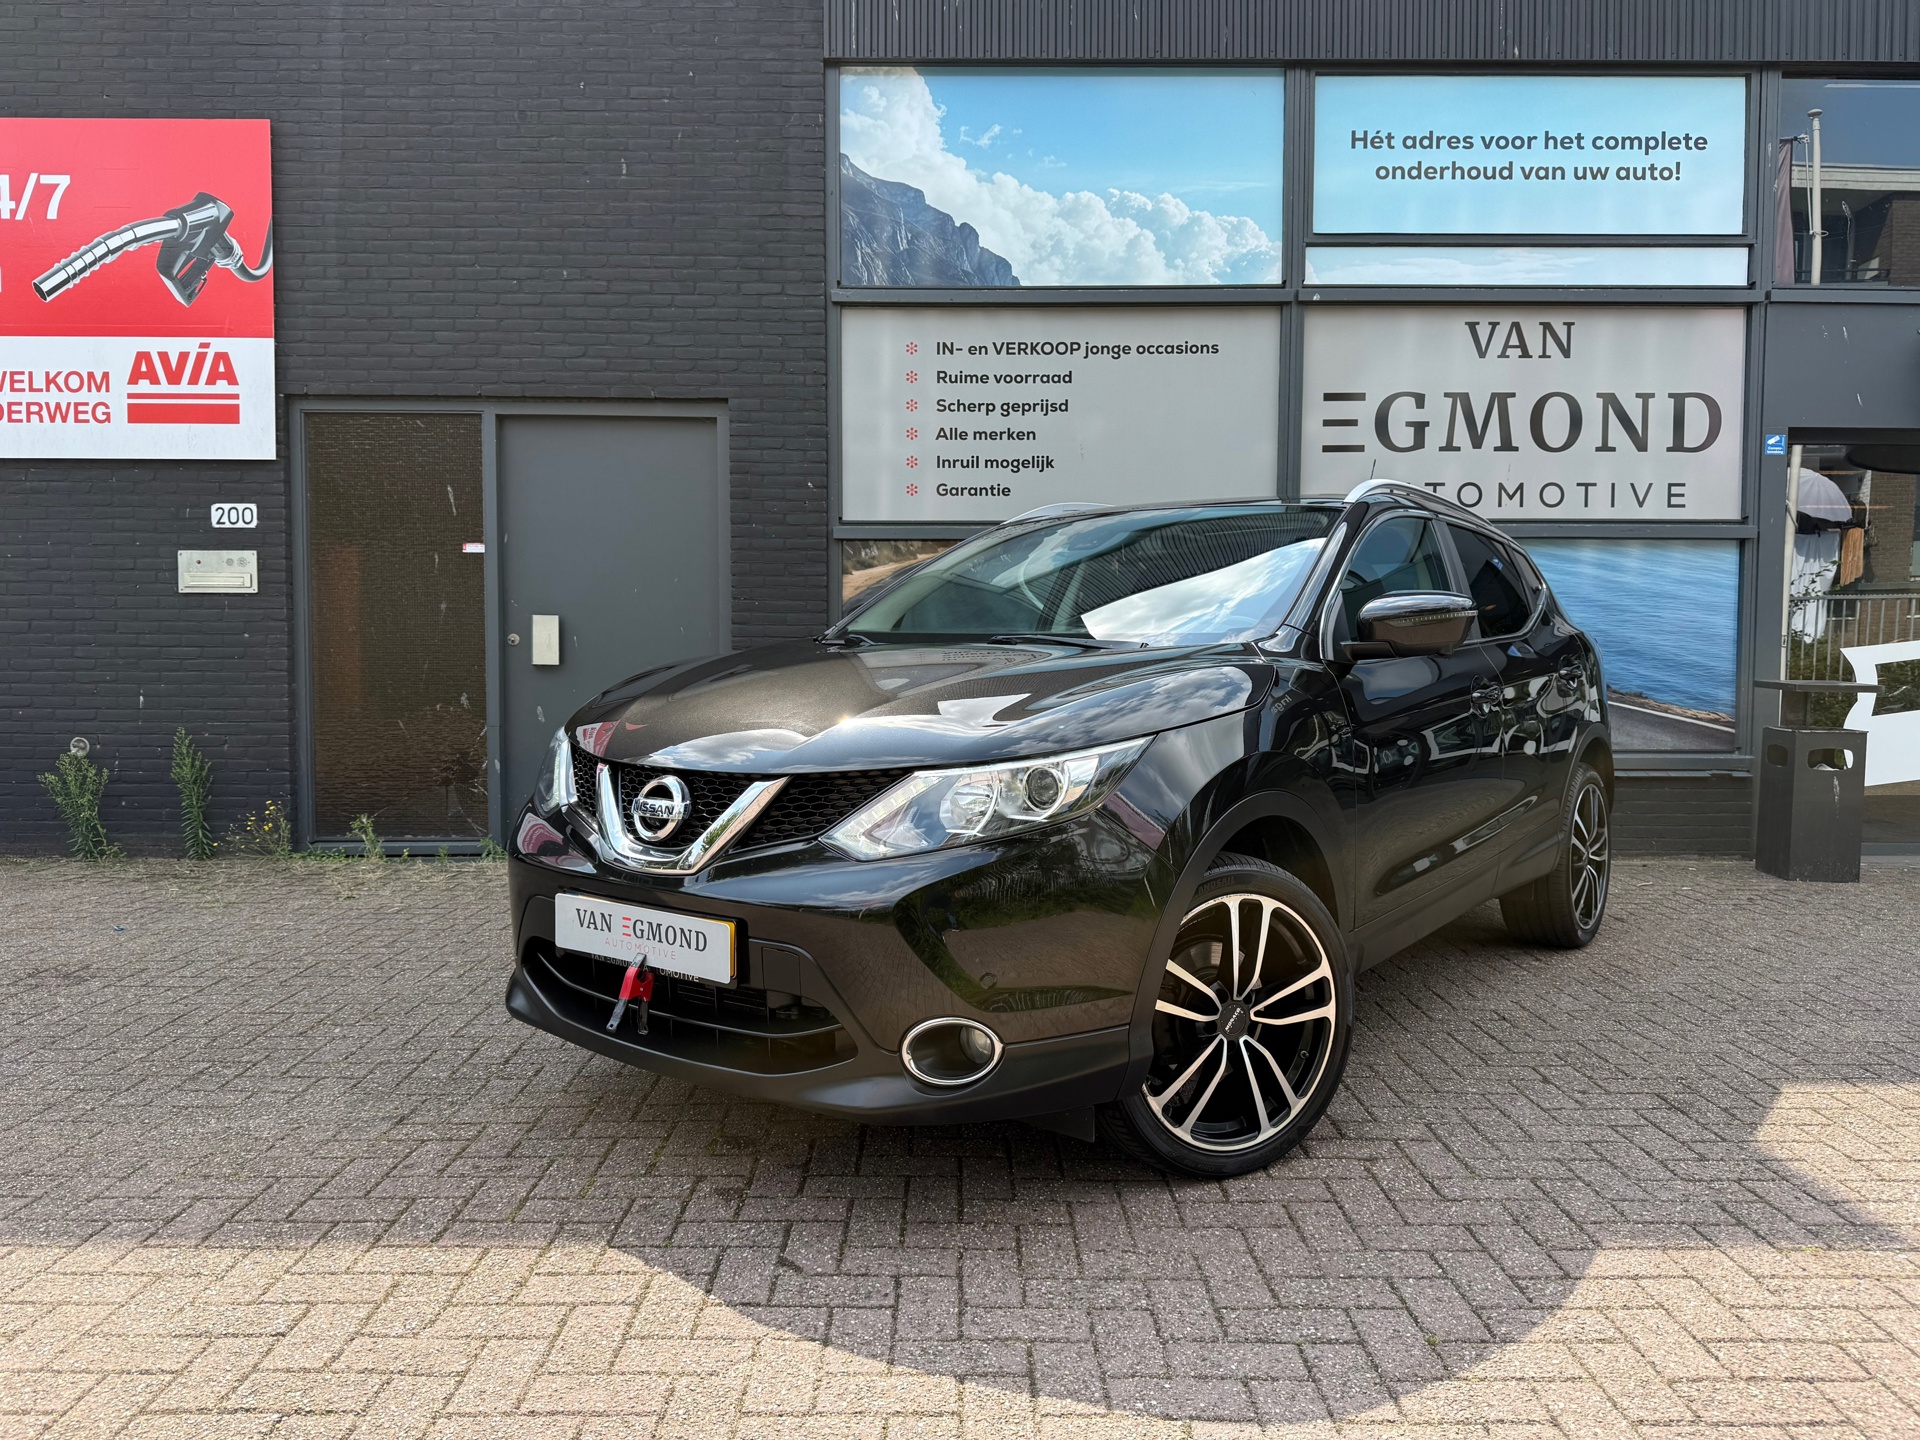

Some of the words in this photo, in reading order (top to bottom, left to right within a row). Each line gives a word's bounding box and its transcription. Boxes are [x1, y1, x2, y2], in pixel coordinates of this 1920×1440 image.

[1350, 129, 1395, 150] Hét
[1402, 130, 1474, 150] adres
[1480, 135, 1538, 150] voor
[1544, 130, 1584, 150] het
[1591, 130, 1708, 156] complete
[1375, 160, 1514, 181] onderhoud
[1519, 166, 1566, 181] van
[1573, 166, 1610, 181] uw
[1615, 161, 1681, 181] auto!
[936, 341, 963, 356] IN-
[967, 345, 988, 356] en
[992, 341, 1081, 356] VERKOOP
[1082, 341, 1132, 360] jonge
[1135, 340, 1220, 355] occasions
[1464, 321, 1576, 359] VAN
[0, 370, 110, 393] ELKOM
[936, 370, 990, 384] Ruime
[993, 370, 1073, 384] voorraad
[0, 401, 111, 424] ERWEG
[936, 398, 996, 416] Scherp
[1000, 398, 1069, 417] geprijsd
[936, 427, 969, 441] Alle
[973, 427, 1036, 441] merken
[936, 455, 980, 469] Inruil
[984, 455, 1055, 474] mogelijk
[936, 482, 1012, 497] Garantie
[1390, 482, 1687, 509] TOMOTIVE
[215, 506, 254, 525] 200
[633, 799, 675, 815] NISSAN
[1196, 876, 1236, 895] ANDSAIL
[575, 908, 613, 933] VAN
[622, 916, 708, 952] EGMOND
[604, 937, 677, 961] AUTOMOTIVE
